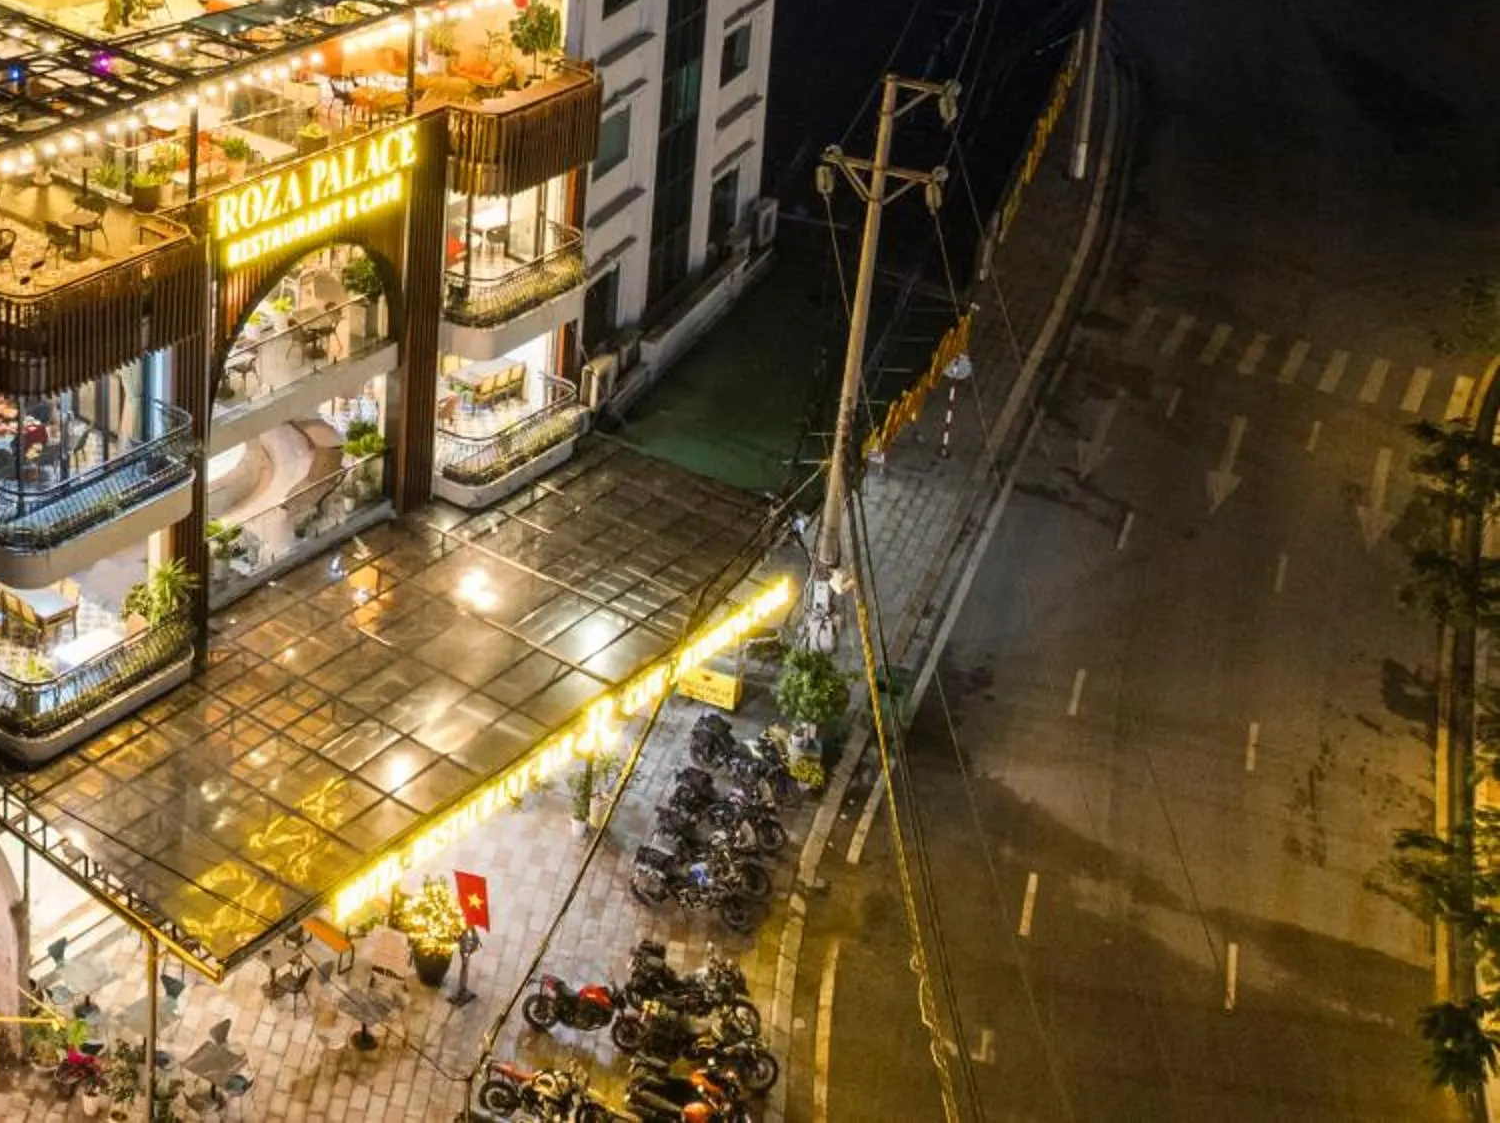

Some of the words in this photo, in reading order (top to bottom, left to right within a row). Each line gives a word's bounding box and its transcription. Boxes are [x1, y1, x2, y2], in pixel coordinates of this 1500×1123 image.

[217, 171, 303, 239] ROZA
[309, 124, 417, 202] PALACE
[227, 202, 343, 268] RESTAURANT
